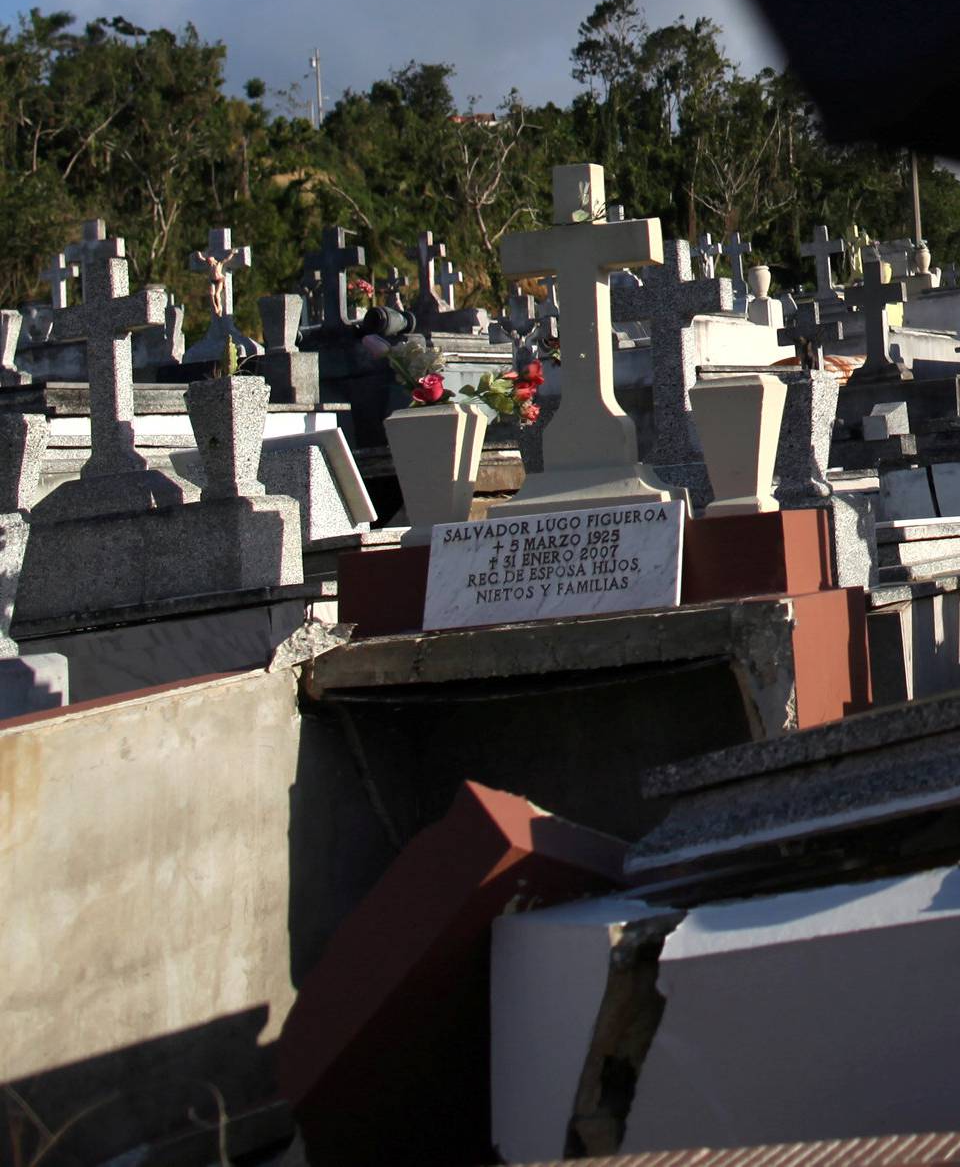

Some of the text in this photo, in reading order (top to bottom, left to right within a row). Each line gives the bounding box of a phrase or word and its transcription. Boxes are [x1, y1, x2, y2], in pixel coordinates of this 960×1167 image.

[444, 507, 668, 543] SALVADOR LUGO FIGUEROA
[509, 529, 620, 553] 5 MARZO 1925
[503, 545, 619, 569] 31 ENERO 2007
[504, 569, 524, 585] DE
[529, 563, 586, 581] ESPOSA
[476, 576, 628, 604] NIETOS Y FAMILIAS
